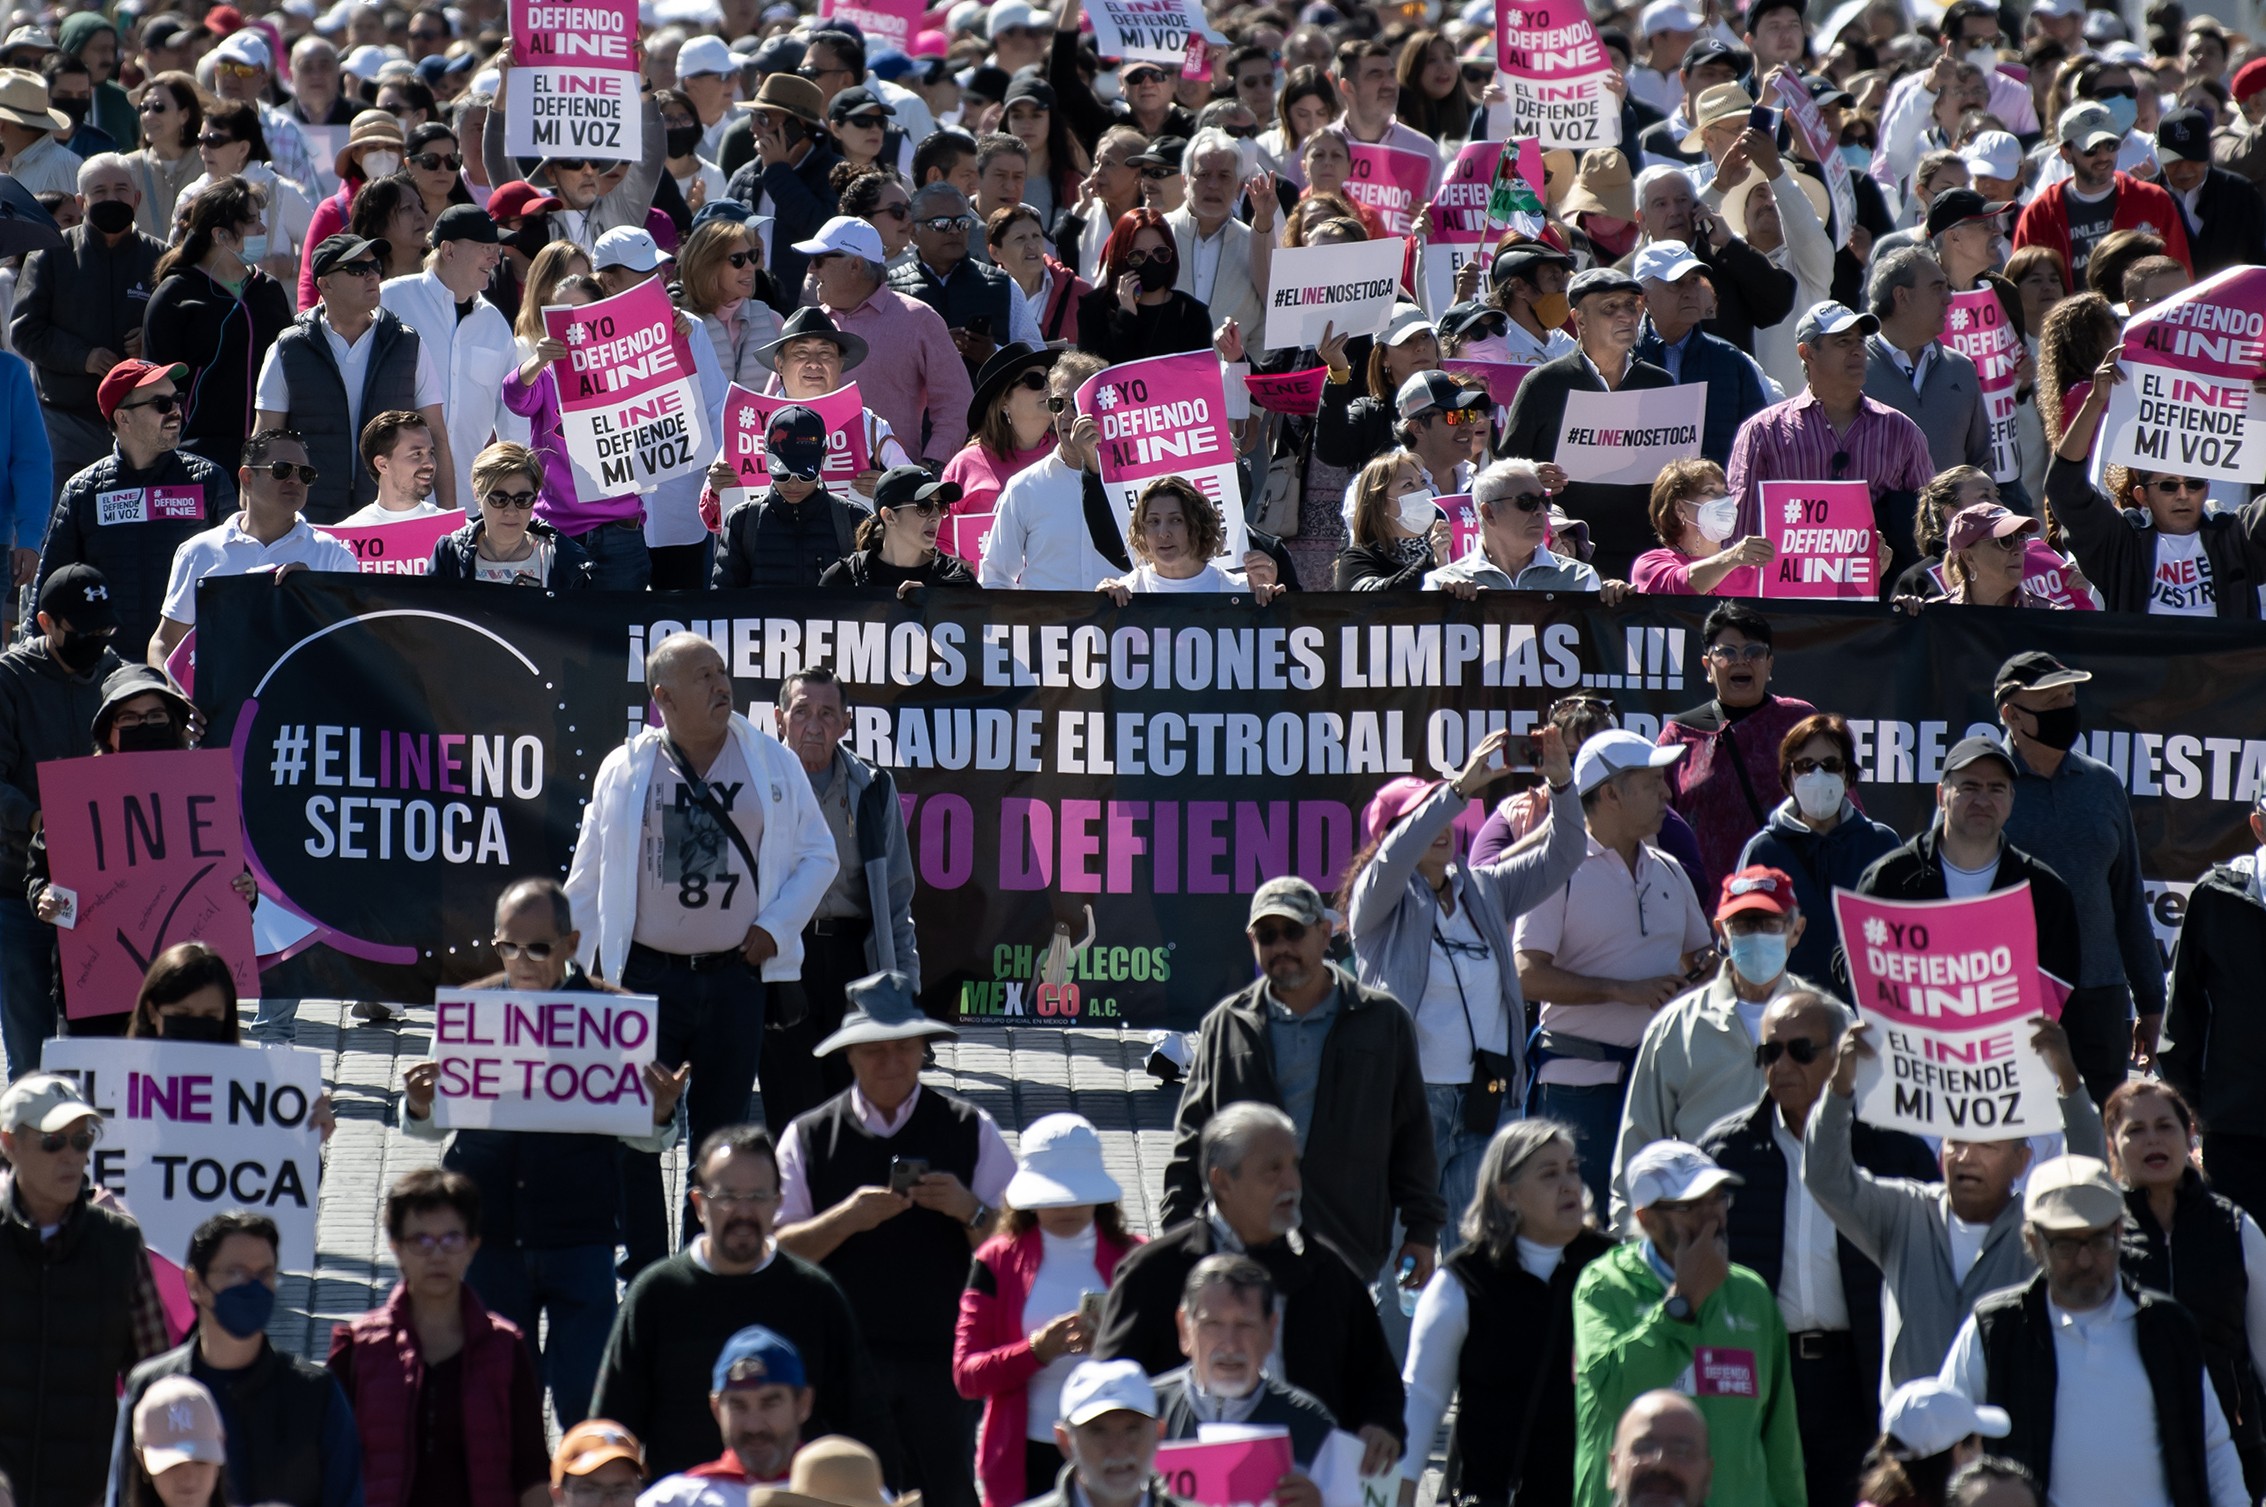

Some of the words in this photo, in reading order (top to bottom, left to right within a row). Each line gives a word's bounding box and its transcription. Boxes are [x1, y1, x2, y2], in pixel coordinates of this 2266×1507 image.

[528, 7, 624, 33] DEFIENDO
[1111, 13, 1192, 28] DEFIENDE
[1126, 0, 1185, 13] INE
[1507, 8, 1550, 28] #YO
[1118, 27, 1146, 49] MI
[1507, 19, 1593, 51] DEFIENDO
[533, 74, 552, 93] EL
[558, 74, 622, 96] INE
[1514, 82, 1534, 99] EL
[1538, 79, 1598, 102] INE
[532, 96, 621, 119] DEFIENDE
[1515, 97, 1599, 120] DEFIENDE
[532, 119, 561, 145] MI
[570, 119, 621, 148] VOZ
[1514, 117, 1541, 137] MI
[1550, 118, 1600, 142] VOZ
[1274, 277, 1394, 308] #ELINENOSETOCA
[566, 315, 616, 346] #YO
[1951, 304, 1996, 330] #YO
[570, 321, 667, 372] DEFIENDO
[1096, 378, 1148, 411] #YO
[1256, 380, 1313, 396] INE
[2143, 373, 2165, 399] EL
[2171, 379, 2250, 410] INE
[591, 414, 615, 436] EL
[618, 389, 683, 429] INE
[738, 405, 770, 431] #Y
[1102, 397, 1209, 441] DEFIENDO
[2139, 399, 2247, 437] DEFIENDE
[596, 411, 688, 459] DEFIENDE
[1567, 424, 1697, 447] #ELINENOSETOCA
[2134, 425, 2170, 460] MI
[2180, 432, 2243, 470] VOZ
[600, 455, 635, 488] MI
[639, 434, 694, 476] VOZ
[102, 496, 111, 504] EL
[112, 491, 138, 502] INE
[103, 500, 139, 512] DEFIENDE
[153, 489, 173, 498] #YO
[154, 497, 195, 507] DEFIENDO
[103, 511, 115, 523] MI
[119, 508, 140, 520] VOZ
[1784, 499, 1828, 524] #YO
[1781, 528, 1871, 554] DEFIENDO
[983, 624, 1326, 691] ELECCIONES
[1057, 709, 1413, 777] ELECTRORAL
[270, 724, 544, 801] #ELINENO
[88, 793, 227, 872] INE
[304, 794, 510, 866] SETOCA
[1862, 916, 1930, 950] #YO
[1867, 945, 2013, 986] DEFIENDO
[1088, 997, 1122, 1017] A.C.
[436, 1001, 495, 1045] EL
[1888, 1030, 1917, 1055] EL
[1923, 1030, 2015, 1065] INE
[438, 1056, 502, 1099] SE
[512, 1058, 648, 1107] TOCA
[1894, 1055, 2020, 1094] DEFIENDE
[126, 1070, 213, 1125] INE
[228, 1079, 308, 1129] NO
[1895, 1082, 1934, 1124] MI
[1945, 1090, 2025, 1128] VOZ
[151, 1155, 309, 1209] TOCA
